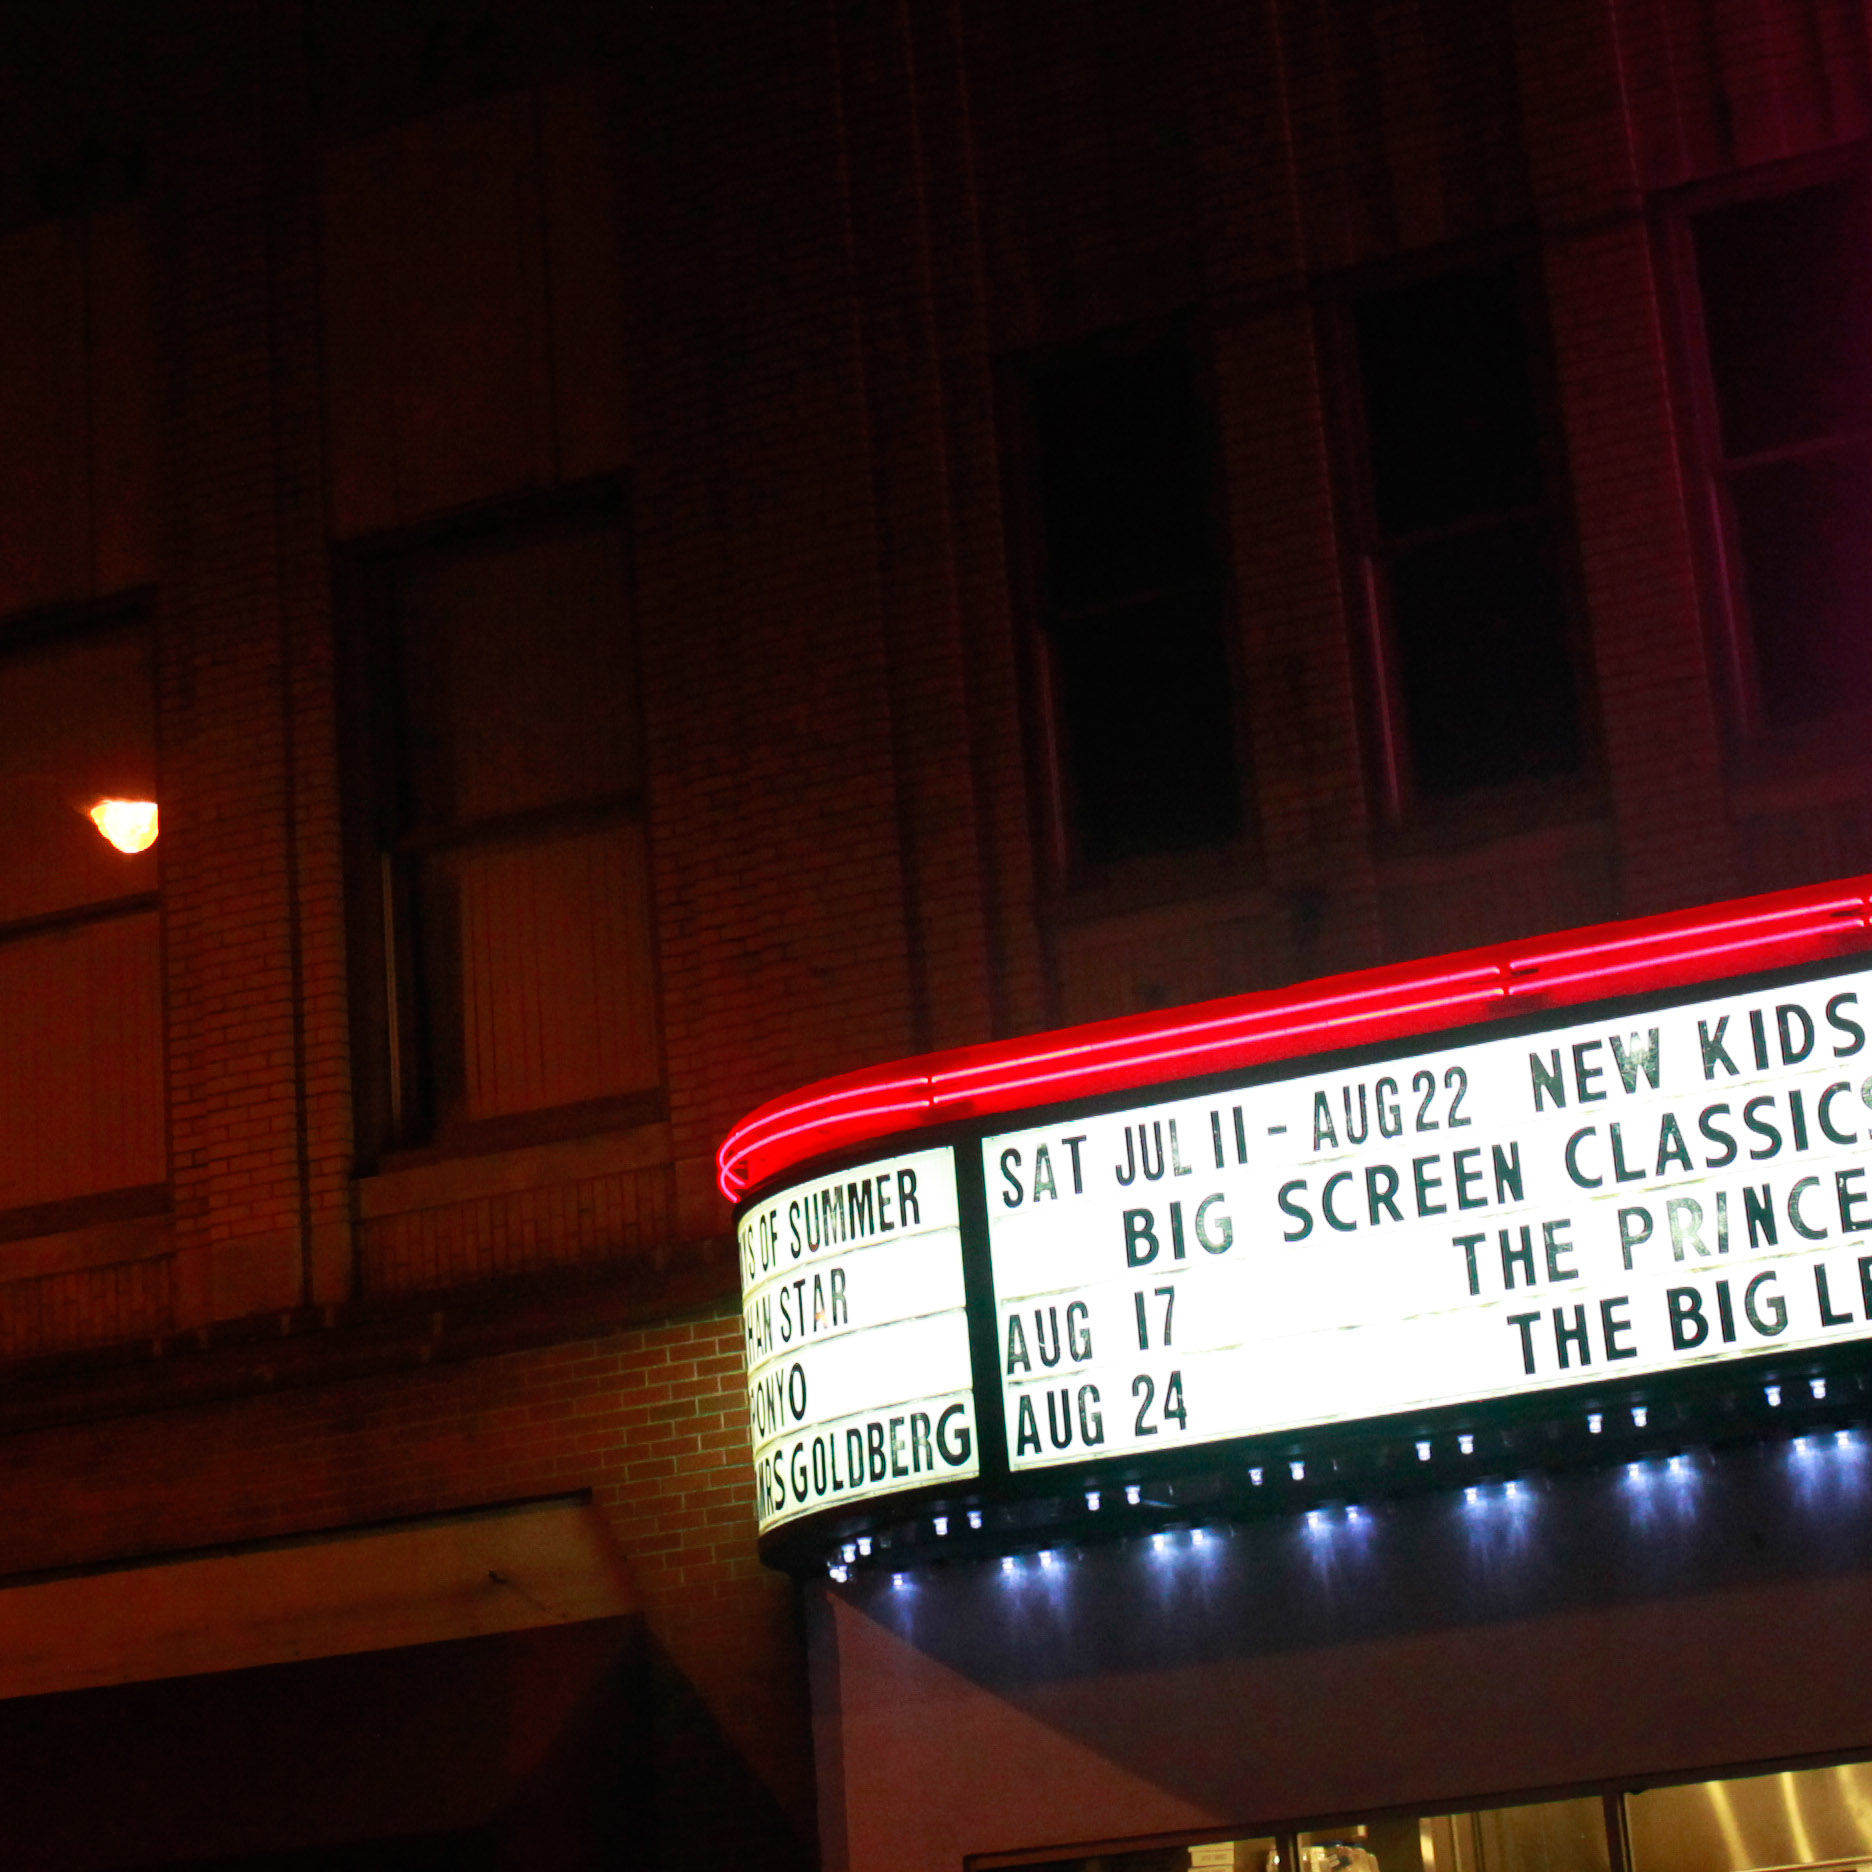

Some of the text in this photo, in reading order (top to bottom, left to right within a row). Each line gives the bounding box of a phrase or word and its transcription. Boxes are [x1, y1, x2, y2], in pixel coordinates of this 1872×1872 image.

[1001, 1135, 1088, 1208] SAT
[1115, 1118, 1195, 1188] JUL
[1529, 1027, 1662, 1113] NEW
[1697, 991, 1866, 1081] KIDS
[759, 1210, 778, 1272] OF
[789, 1167, 921, 1260] SUMMER
[1124, 1191, 1235, 1269] BIG
[1278, 1140, 1524, 1243] SCREEN
[780, 1267, 849, 1343] STAR
[1005, 1299, 1093, 1378] AUG
[1133, 1286, 1178, 1352] 17
[1453, 1220, 1578, 1296] THE
[1015, 1381, 1105, 1458] AUG
[1131, 1369, 1190, 1438] 24
[1506, 1296, 1639, 1376] THE
[1666, 1269, 1790, 1352] BIG
[790, 1403, 972, 1503] GOLDBERG
